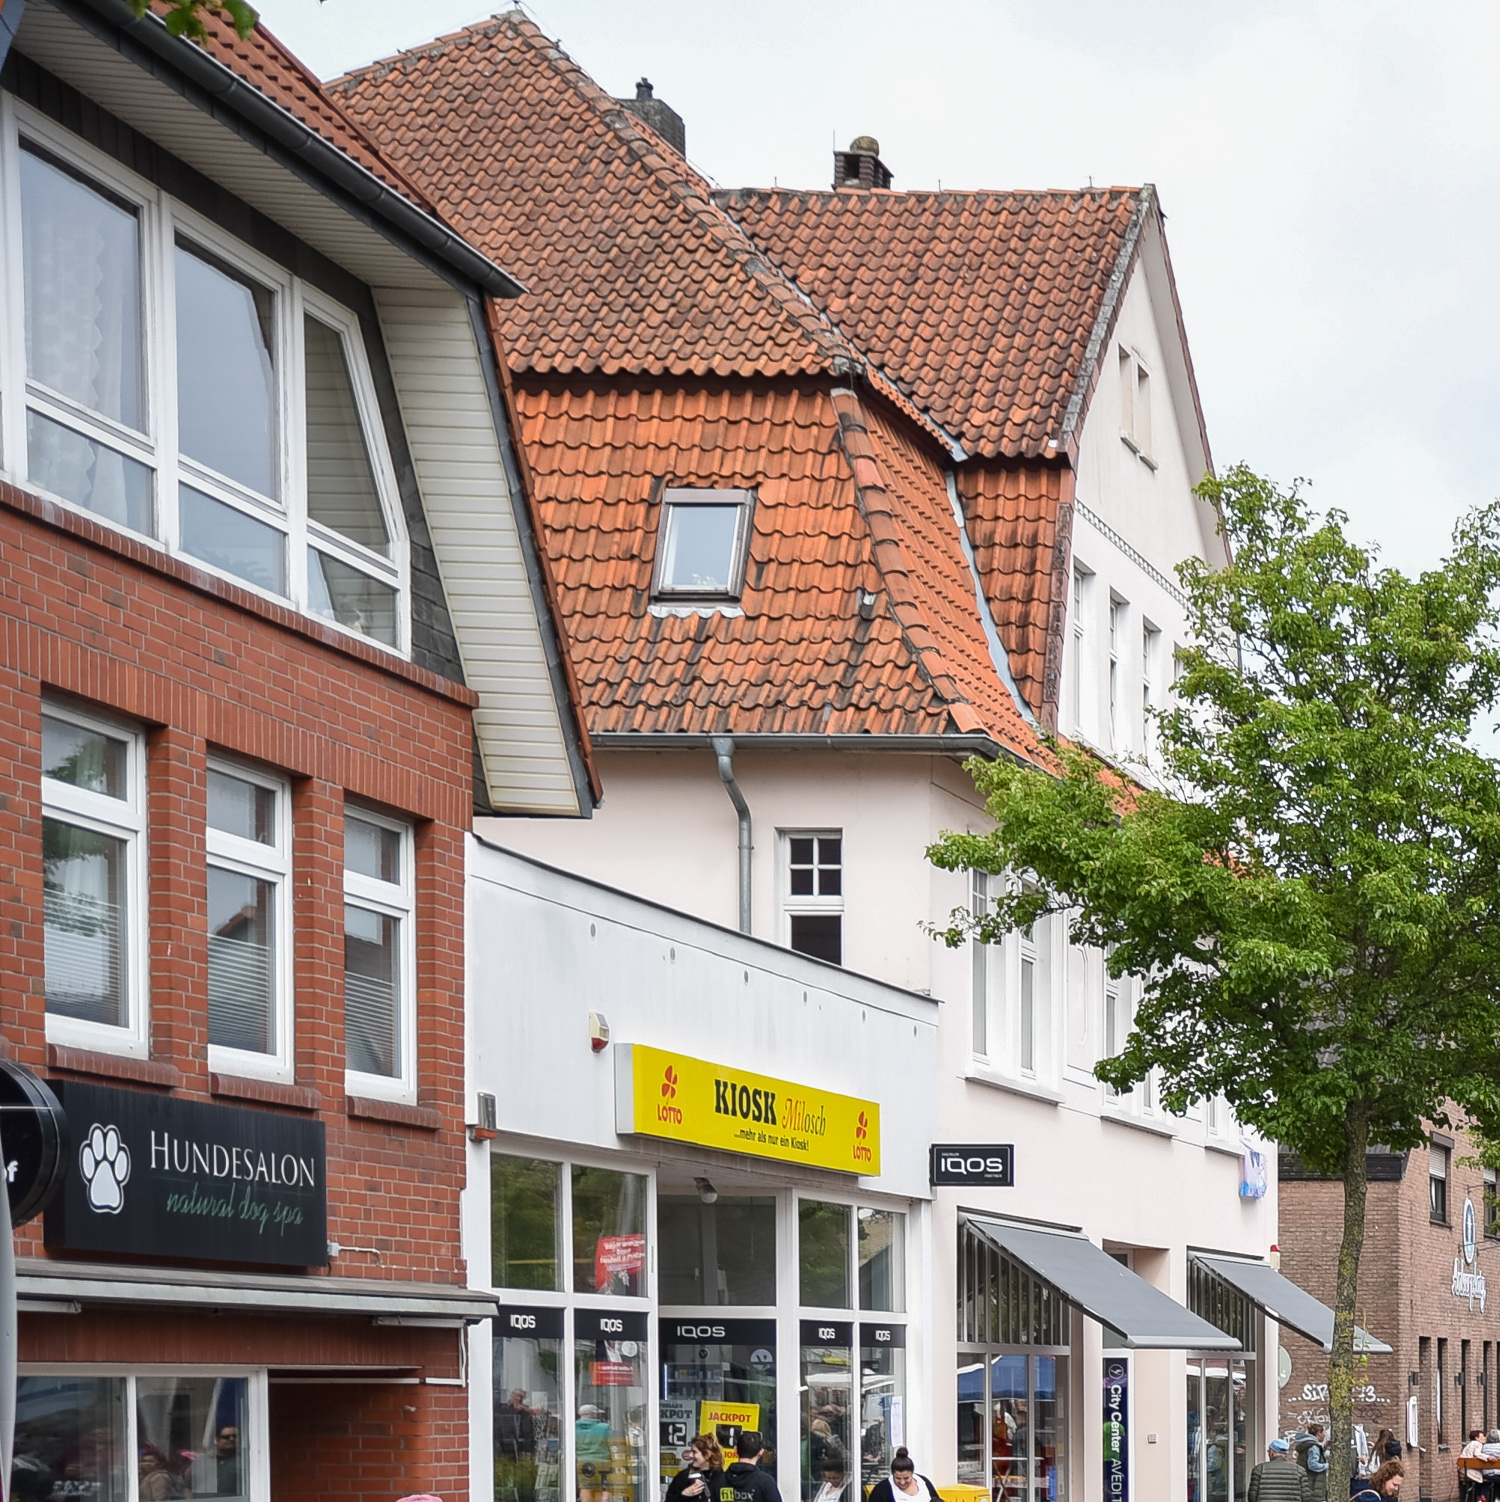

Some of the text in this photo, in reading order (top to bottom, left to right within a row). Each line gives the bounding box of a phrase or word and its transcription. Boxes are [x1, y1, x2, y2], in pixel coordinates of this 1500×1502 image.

[657, 1104, 682, 1125] LOTTO
[714, 1078, 827, 1136] KIOSK Milosch
[757, 1131, 766, 1143] als
[767, 1135, 779, 1146] nur
[780, 1135, 790, 1148] ein
[791, 1138, 809, 1151] Kiosk!
[151, 1130, 315, 1187] HUNDESALON
[853, 1144, 872, 1162] LOTTO
[941, 1157, 1003, 1175] IQOS
[167, 1181, 303, 1236] natural dog spa
[510, 1314, 536, 1330] IQOS
[600, 1318, 623, 1333] IQOS
[677, 1325, 726, 1339] IQOS
[818, 1327, 836, 1340] IQOS
[875, 1329, 891, 1341] IQOS
[1109, 1384, 1122, 1410] City
[660, 1409, 692, 1419] KPOT
[708, 1412, 752, 1423] JACKPOT
[1111, 1411, 1122, 1453] Center
